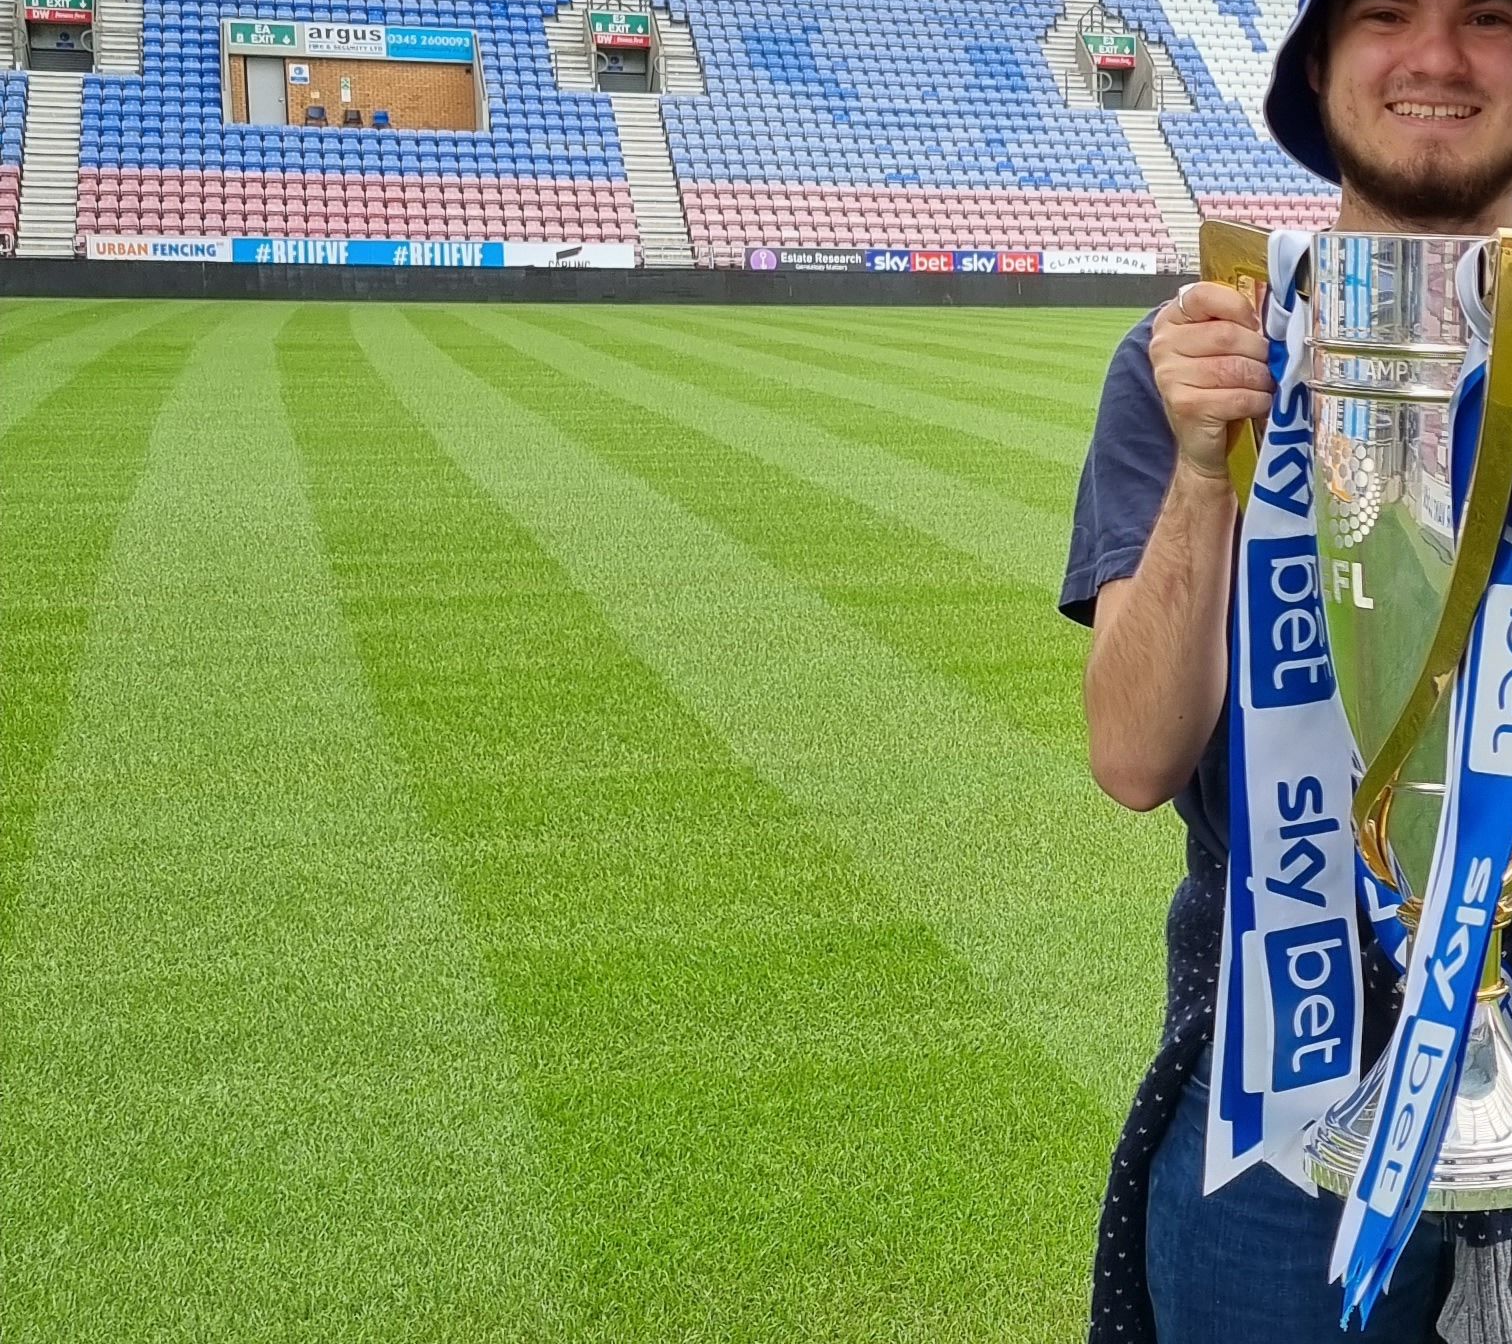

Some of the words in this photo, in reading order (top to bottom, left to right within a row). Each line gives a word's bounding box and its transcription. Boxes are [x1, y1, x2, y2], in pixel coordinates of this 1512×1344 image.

[32, 9, 50, 19] DW
[254, 24, 271, 34] EA
[308, 27, 382, 44] argus
[608, 24, 630, 33] EXIT
[251, 33, 276, 45] EXIT
[388, 33, 417, 46] 0345
[420, 35, 470, 48] 2600093
[96, 242, 149, 256] URBAN
[152, 243, 217, 257] FENCING
[780, 252, 812, 264] Estate
[814, 252, 862, 264] Research
[875, 252, 909, 272] sky
[915, 254, 948, 272] bet
[962, 252, 996, 272] sky
[1002, 255, 1035, 272] bet
[1049, 255, 1109, 270] CLAYTON
[1115, 256, 1147, 271] PARK
[1253, 384, 1314, 518] sky
[1270, 553, 1332, 692] bet
[1265, 775, 1341, 908] sky
[1431, 856, 1492, 1009] sky
[1285, 937, 1343, 1073] bet
[1373, 1048, 1444, 1206] bet
